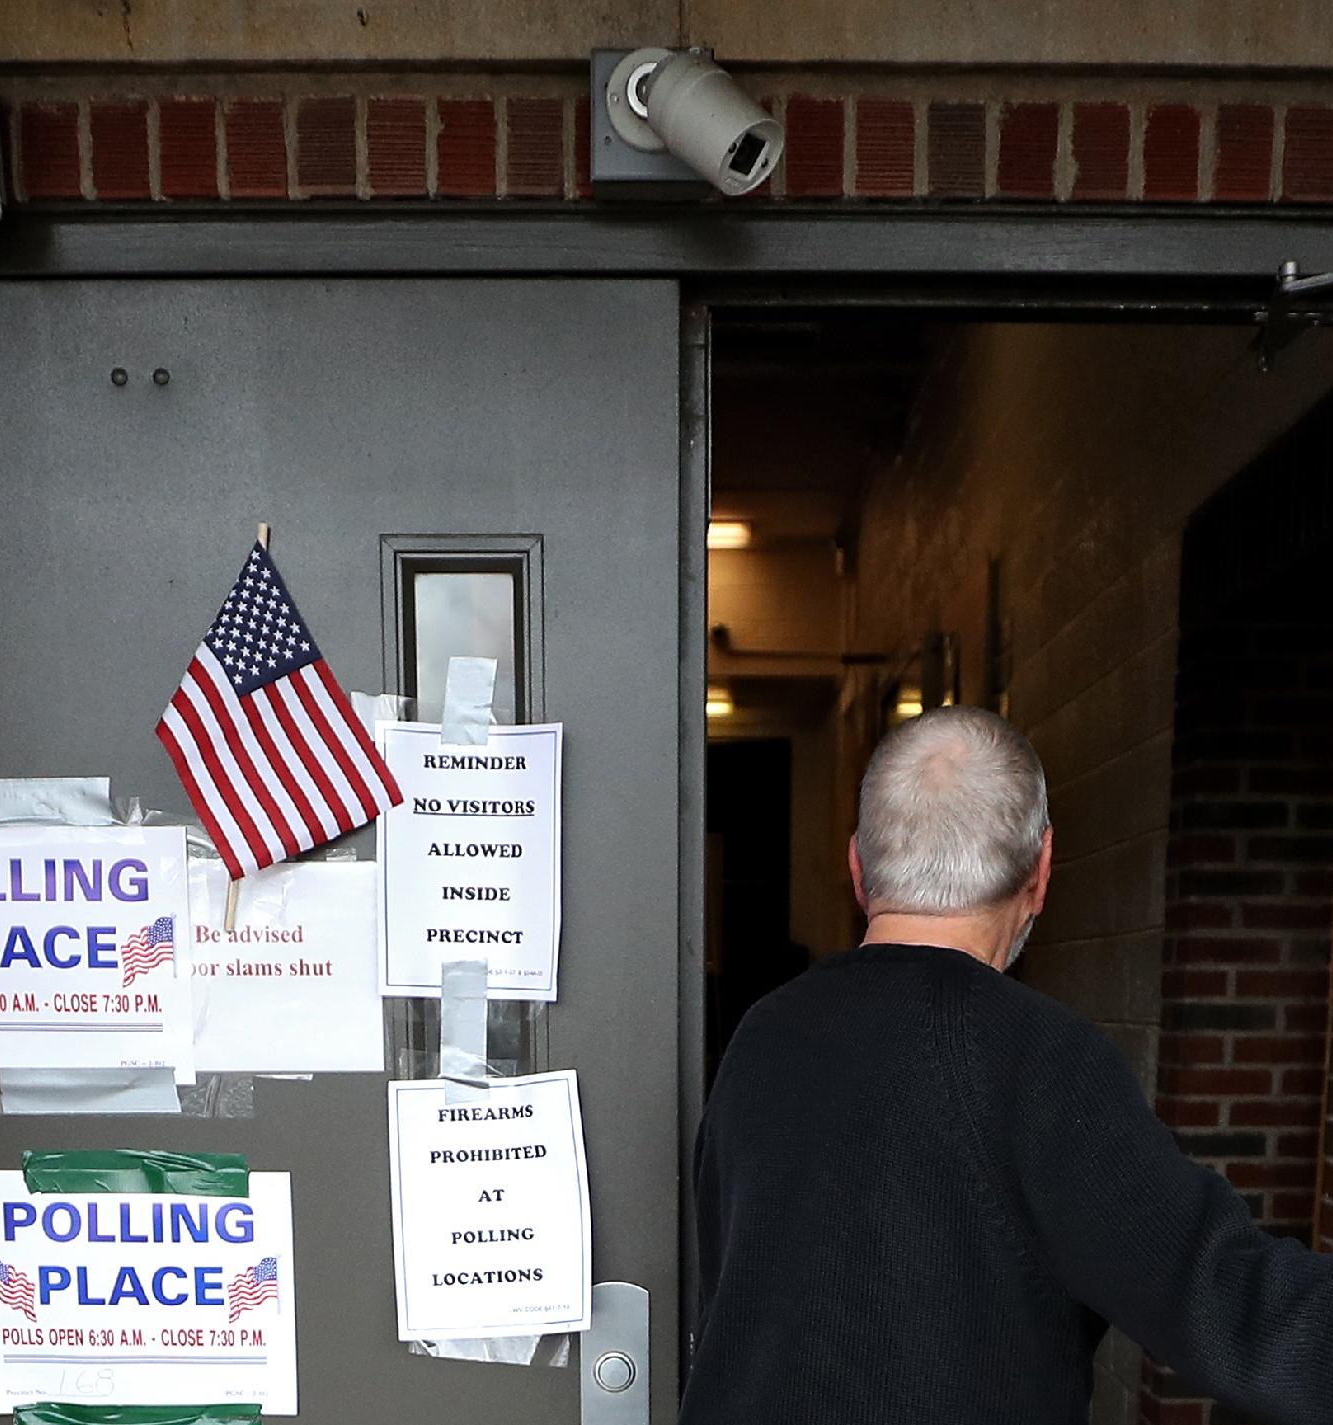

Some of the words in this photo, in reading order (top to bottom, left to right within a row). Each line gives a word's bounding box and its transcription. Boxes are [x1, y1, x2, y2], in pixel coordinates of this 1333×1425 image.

[423, 754, 527, 771] REMINDER
[413, 797, 441, 812] NO
[446, 799, 536, 815] VISITORS
[427, 843, 523, 859] ALLOWED
[442, 886, 511, 902] INSIDE
[195, 925, 221, 944] Be
[228, 925, 304, 944] advised
[426, 928, 524, 945] PRECINCT
[191, 962, 219, 977] or
[226, 958, 283, 977] slams
[289, 958, 333, 977] shut
[12, 993, 39, 1012] A.M.
[54, 993, 98, 1013] CLOSE
[102, 994, 129, 1013] 7:30
[135, 994, 162, 1013] P.M.
[437, 1104, 534, 1122] FIREARMS
[429, 1144, 547, 1164] PROHIBITED
[477, 1189, 505, 1203] AT
[3, 1202, 255, 1244] POLLING
[451, 1228, 535, 1245] POLLING
[38, 1266, 225, 1306] PLACE
[432, 1268, 544, 1287] LOCATIONS
[2, 1328, 44, 1346] POLLS
[49, 1328, 84, 1346] OPEN
[88, 1329, 115, 1347] 6:30
[120, 1328, 146, 1346] A.M.
[161, 1328, 204, 1347] CLOSE
[209, 1330, 235, 1347] 7:30
[240, 1329, 267, 1347] P.M.
